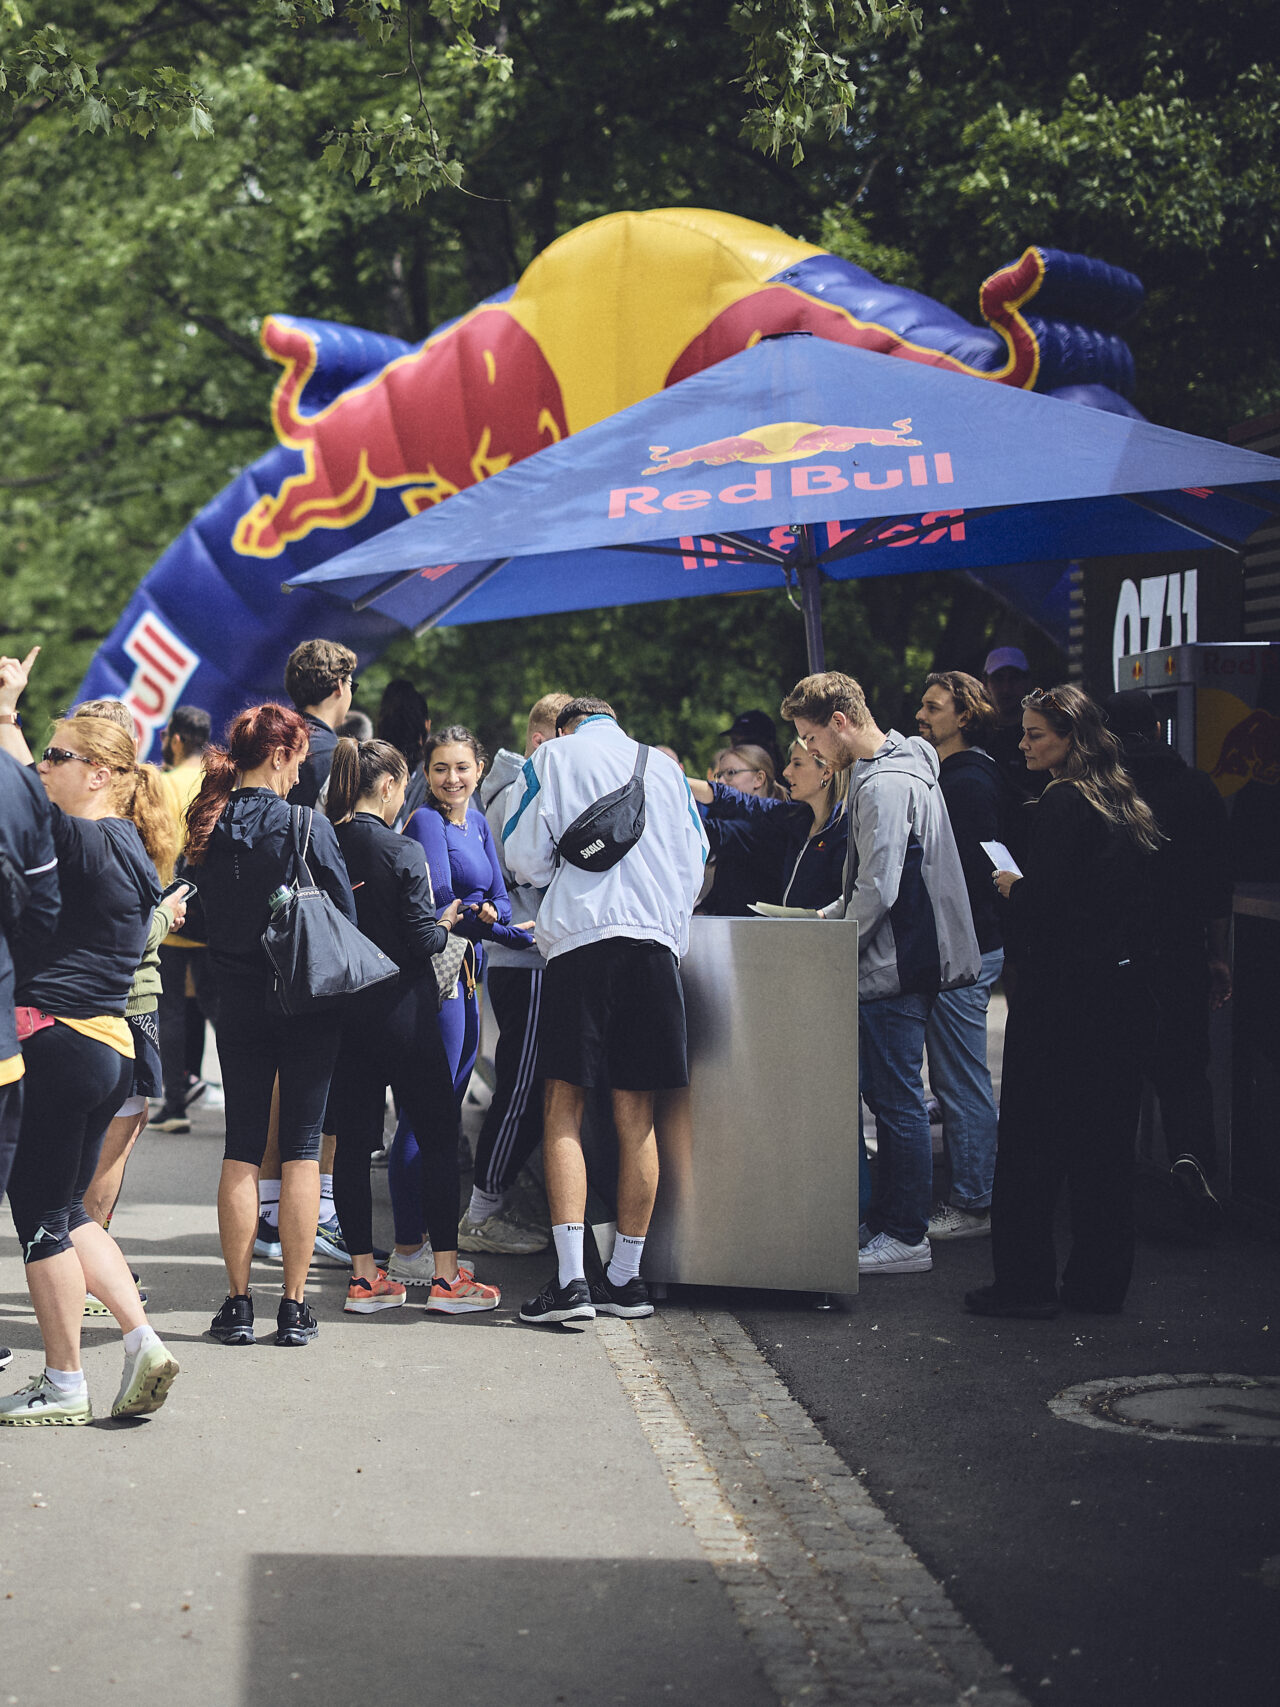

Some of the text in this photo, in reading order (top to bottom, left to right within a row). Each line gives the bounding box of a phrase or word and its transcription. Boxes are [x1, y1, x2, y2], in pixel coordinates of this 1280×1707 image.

[608, 452, 955, 519] Red Bull
[131, 622, 189, 744] ull
